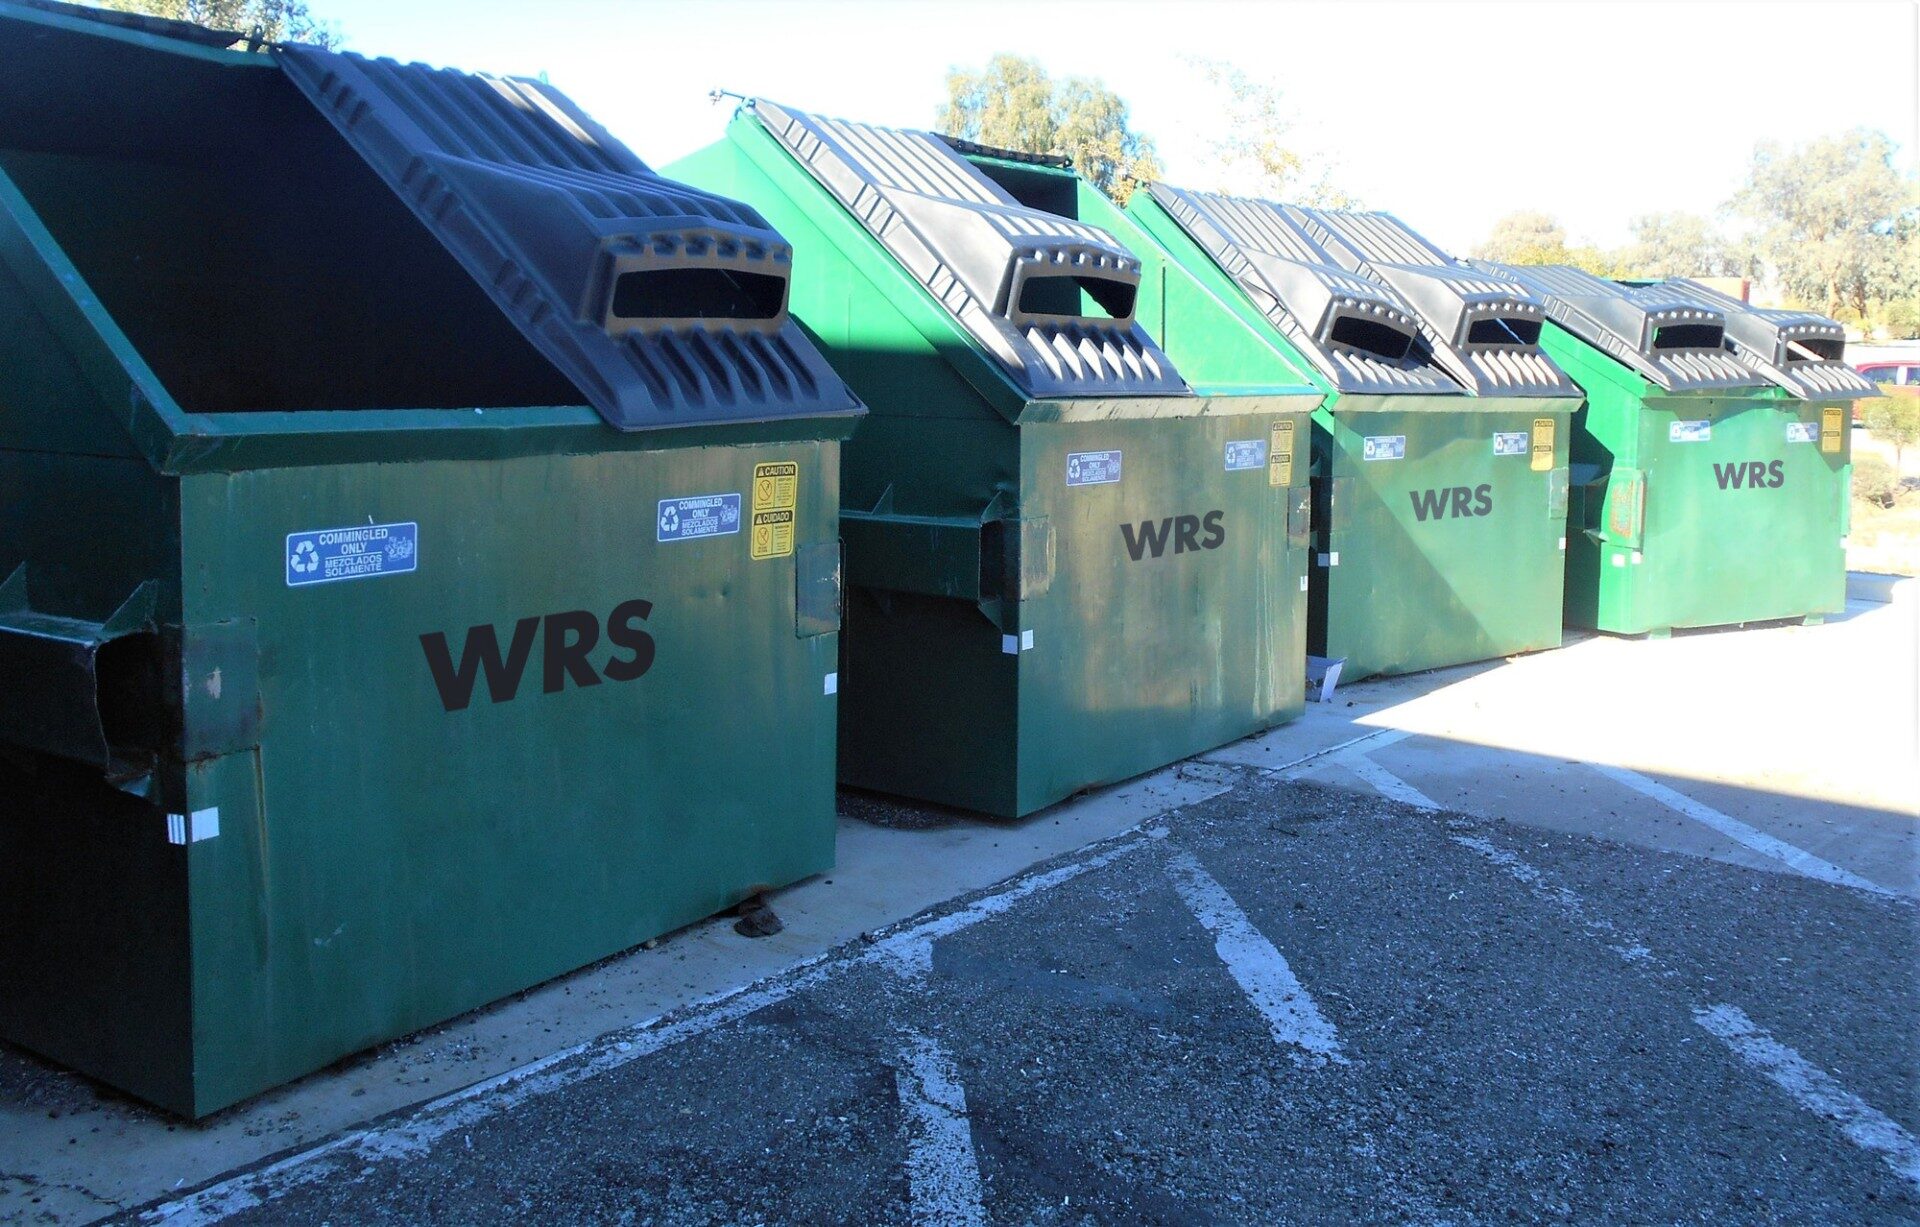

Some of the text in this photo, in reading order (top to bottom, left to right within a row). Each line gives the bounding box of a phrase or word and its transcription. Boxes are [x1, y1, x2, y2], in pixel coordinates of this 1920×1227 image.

[765, 465, 794, 475] CAUTION
[1713, 460, 1784, 490] WRS
[679, 498, 723, 510] COMMINGLED
[1408, 484, 1492, 521] WRS
[692, 508, 709, 519] ONLY
[763, 512, 789, 523] CUIDADO
[319, 528, 388, 545] COMMINGLED
[1119, 510, 1225, 562] WRS
[341, 542, 367, 555] ONLY
[325, 554, 382, 568] MEZCLADOS
[325, 563, 382, 577] SOLAMENTE
[419, 599, 656, 713] WRS
